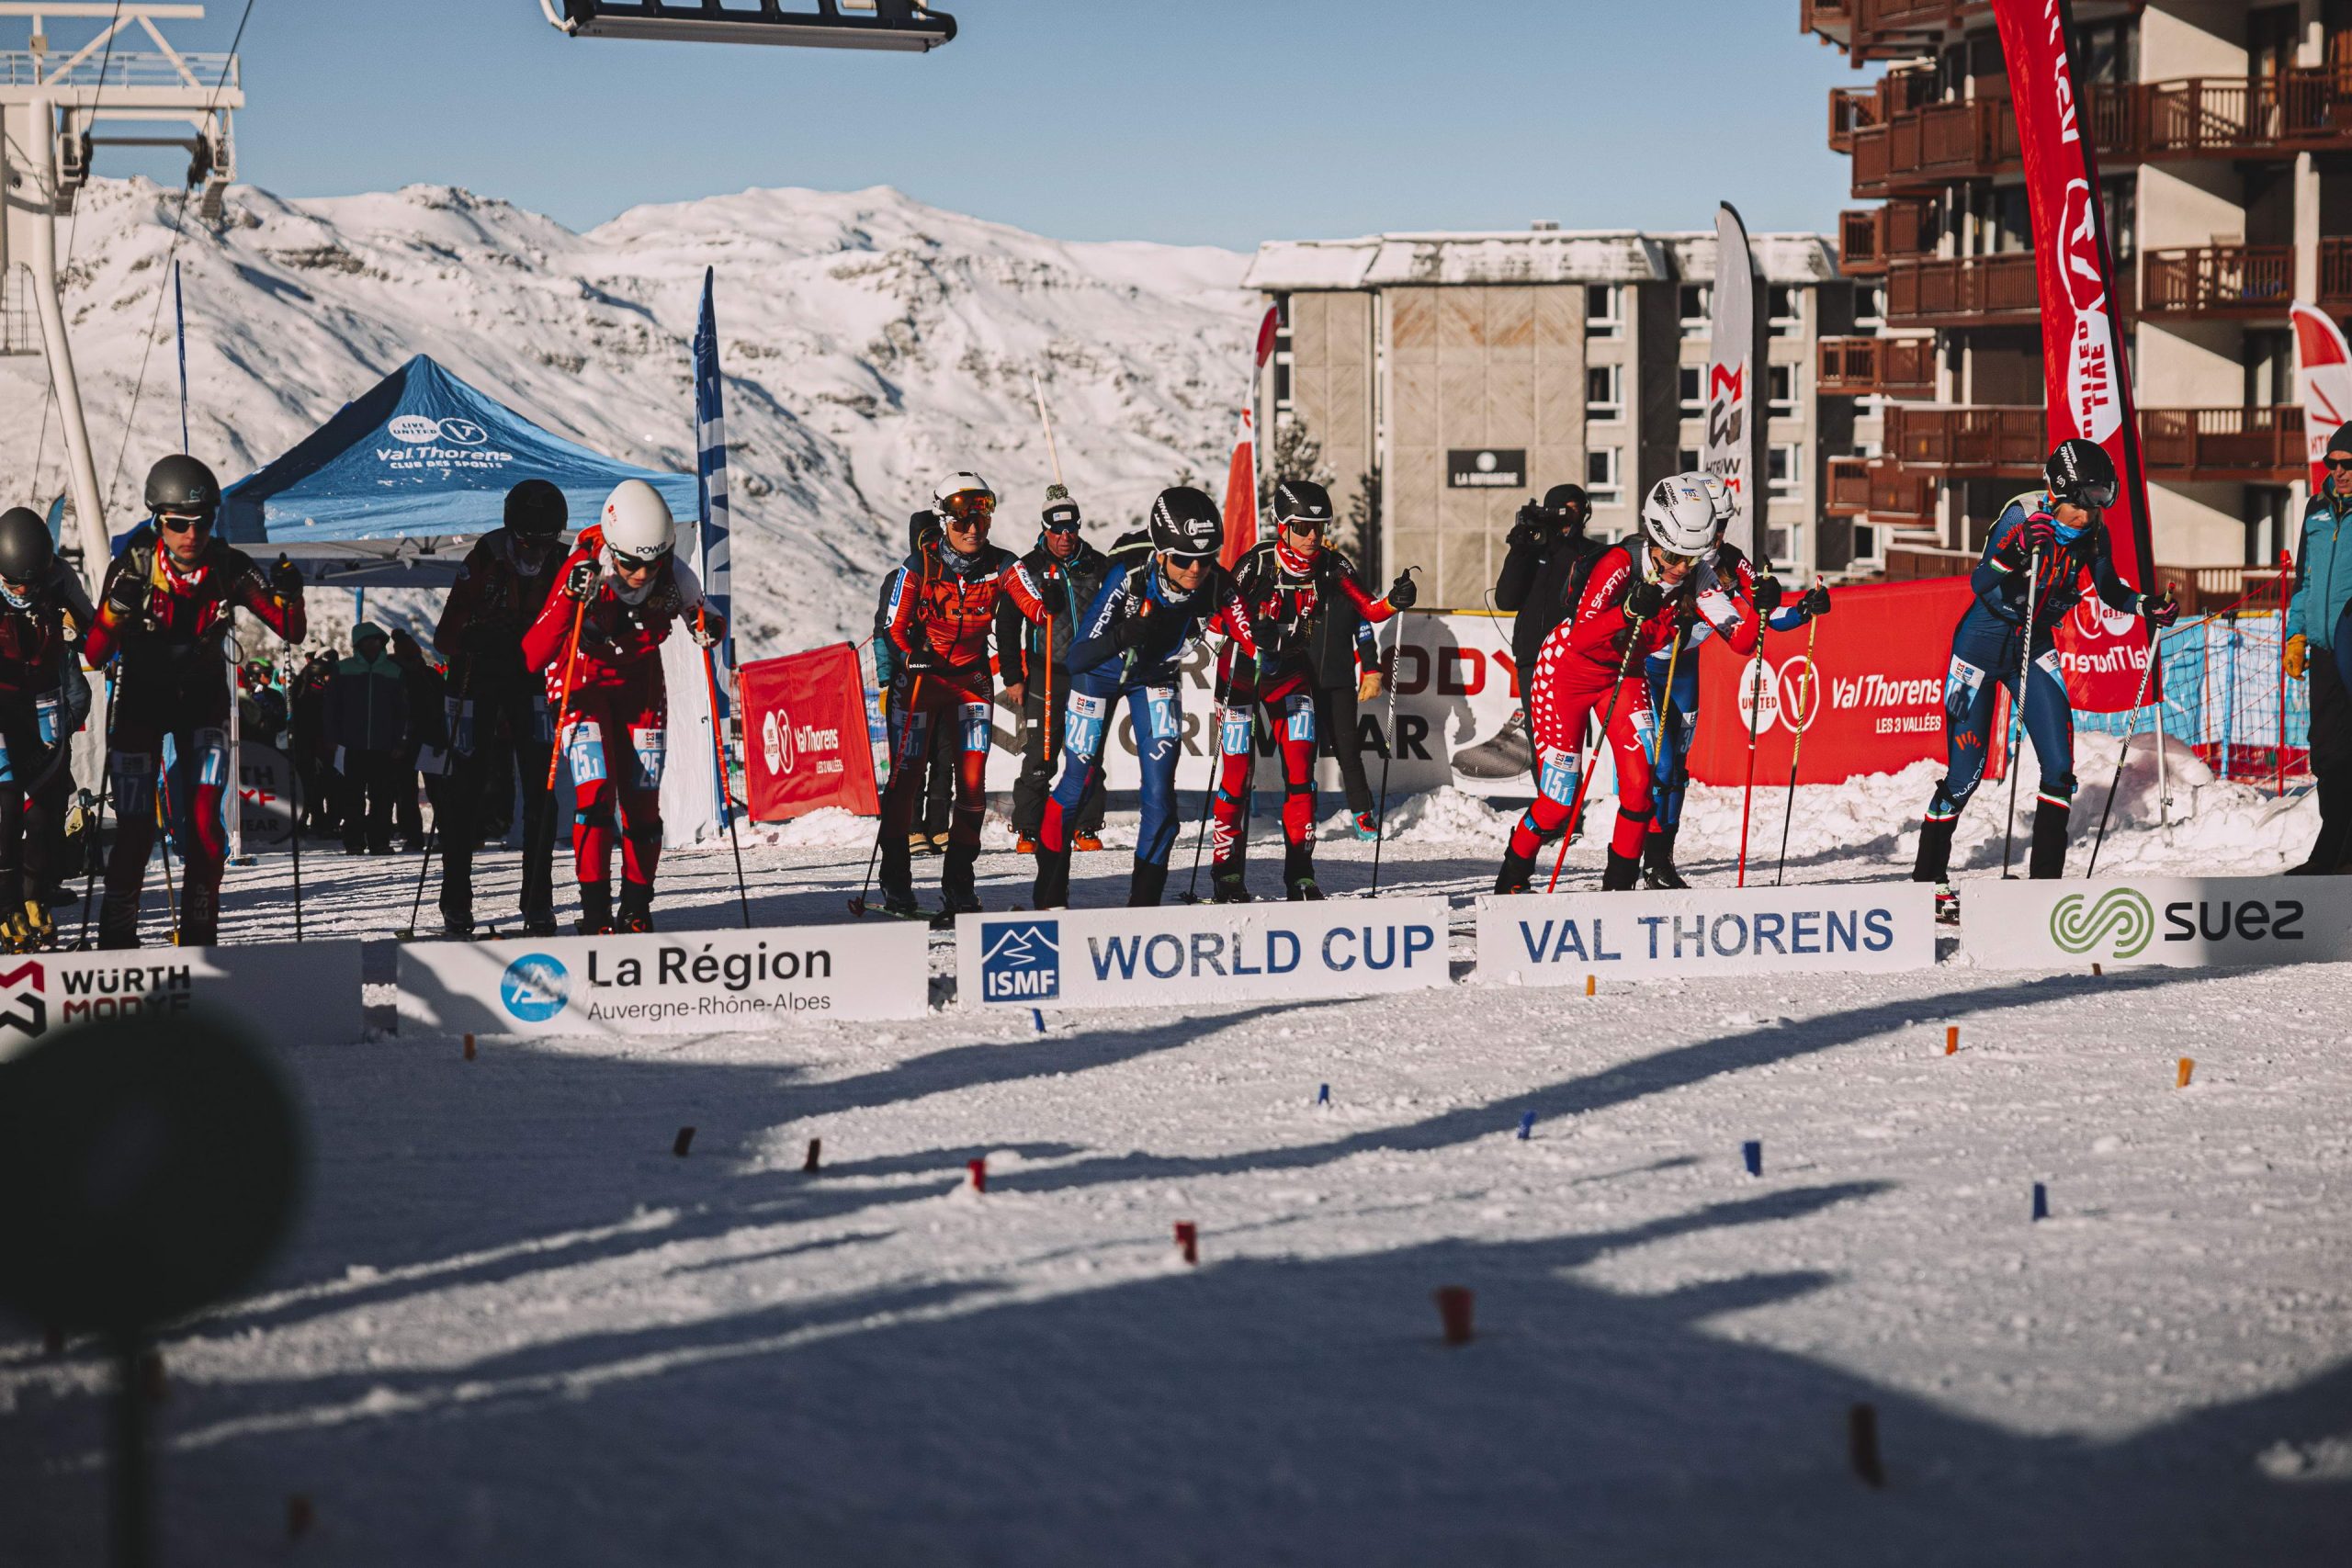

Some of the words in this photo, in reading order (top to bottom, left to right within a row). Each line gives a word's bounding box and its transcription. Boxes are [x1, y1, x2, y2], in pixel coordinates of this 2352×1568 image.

[377, 447, 413, 461] Val
[416, 446, 514, 461] Thorens
[390, 461, 423, 469] CLUB
[454, 460, 503, 468] SPORTS
[1665, 481, 1679, 505] ATOMIC
[1832, 676, 1864, 709] Val
[1865, 673, 1942, 707] Thorens
[806, 725, 839, 751] Thorens
[1067, 715, 1095, 753] 24.1
[1876, 718, 1894, 734] LES
[1894, 717, 1901, 732] 3
[1902, 713, 1942, 732] VALLÉES
[571, 744, 600, 784] 25.1
[1543, 768, 1568, 803] 15.1
[1518, 918, 1622, 964] VAL
[1637, 908, 1894, 960] THORENS
[588, 949, 642, 987] La
[659, 942, 831, 991] Région
[1087, 930, 1301, 981] WORLD
[1320, 924, 1434, 972] CUP
[62, 964, 190, 995] WÜRTH
[989, 969, 1056, 997] ISMF
[587, 992, 831, 1021] Auvergne-Rhône-Alpes
